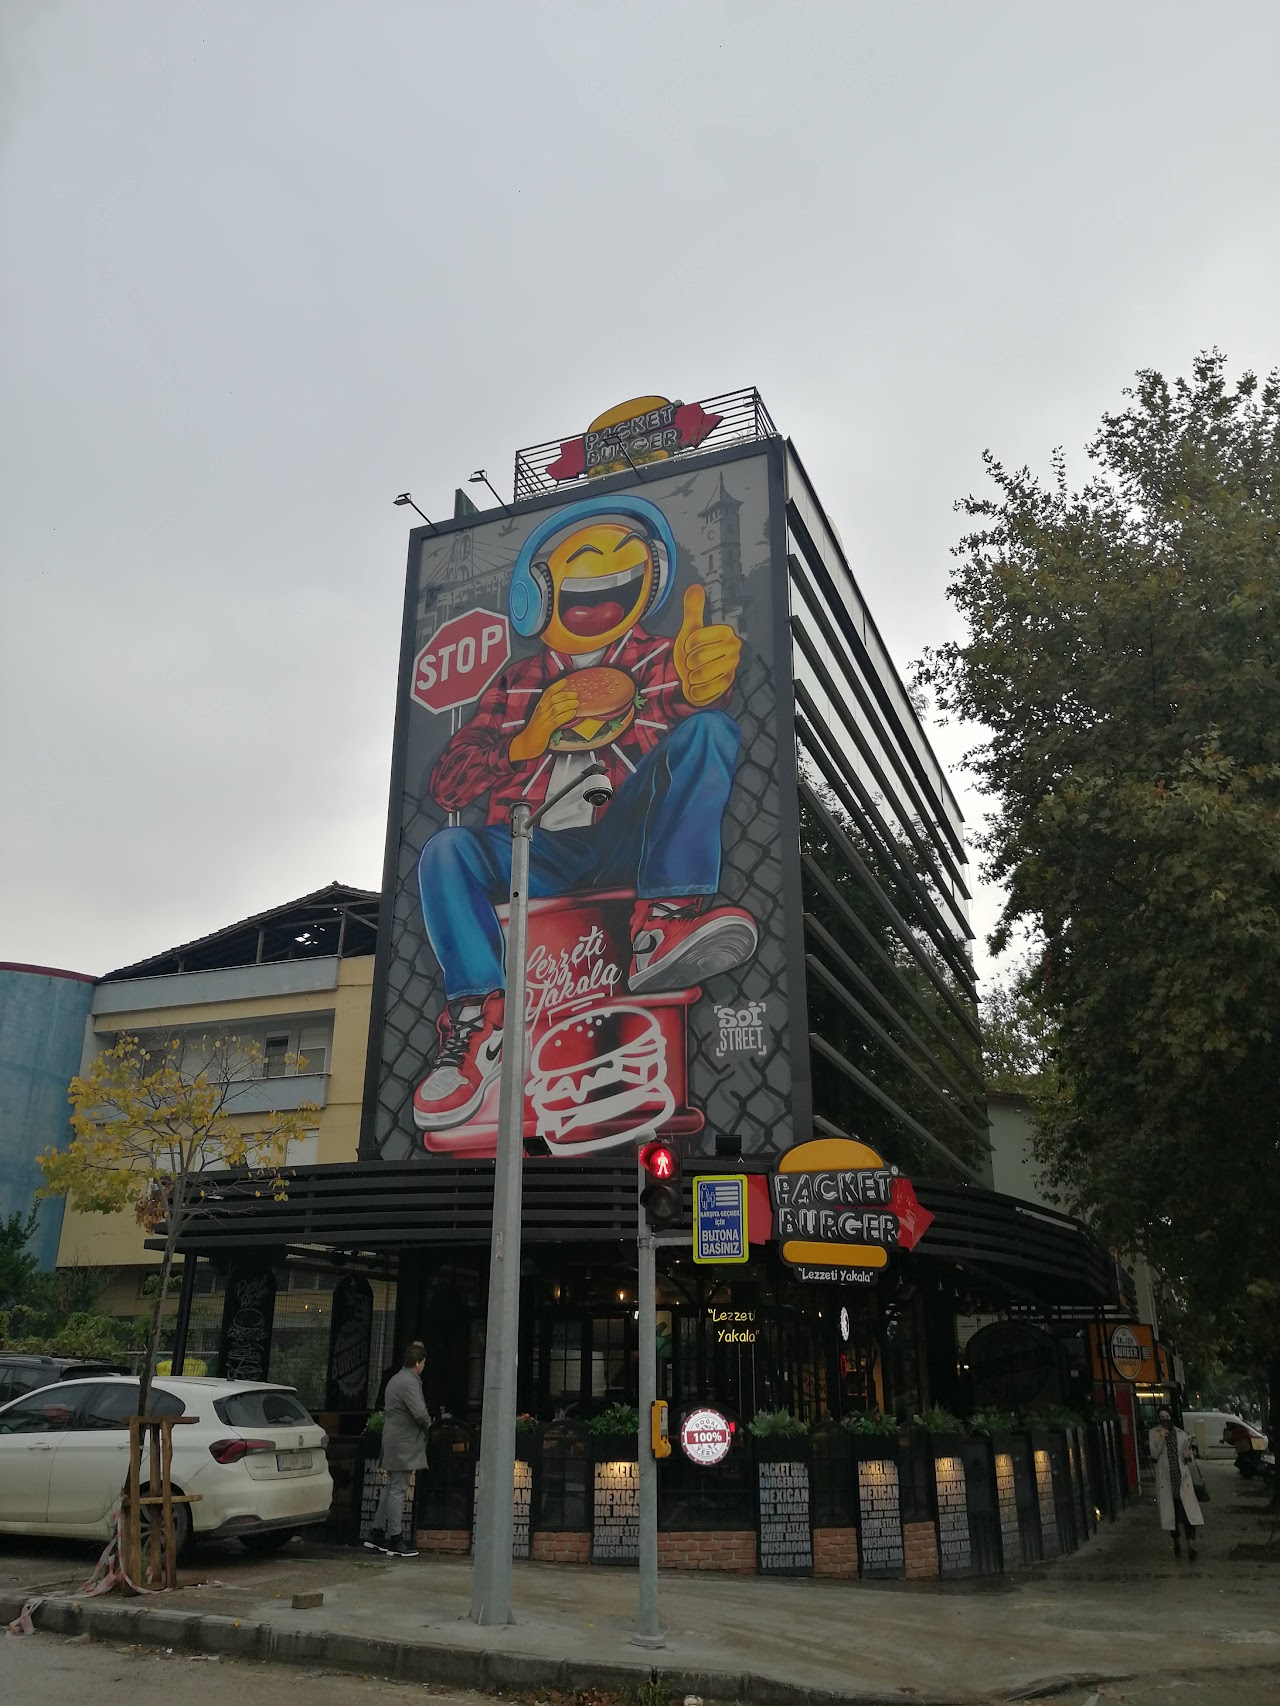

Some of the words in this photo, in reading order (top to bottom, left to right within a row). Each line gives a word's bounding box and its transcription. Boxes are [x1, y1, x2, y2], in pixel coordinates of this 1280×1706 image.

[585, 405, 674, 451] PACKET
[586, 429, 677, 466] BURGER
[416, 624, 503, 690] STOP
[720, 1027, 763, 1051] STREET
[774, 1170, 892, 1206] PACKET
[779, 1207, 898, 1242] BURGER
[702, 1229, 739, 1242] BUTONA
[1114, 1346, 1138, 1358] BURGER
[693, 1431, 722, 1443] 100%
[594, 1462, 631, 1477] PACKET
[759, 1463, 790, 1477] PACKET
[594, 1490, 639, 1505] MEXICA
[760, 1489, 809, 1503] MEXICAN
[859, 1485, 899, 1500] MEXICAN
[787, 1522, 809, 1533] STEAK
[594, 1536, 620, 1546] CHEESE
[761, 1533, 784, 1541] CHEESE
[862, 1536, 902, 1549] MUSHROOM
[761, 1541, 810, 1553] MUSHROOM
[761, 1554, 794, 1568] VEGGIE
[862, 1549, 889, 1563] VEGGIE
